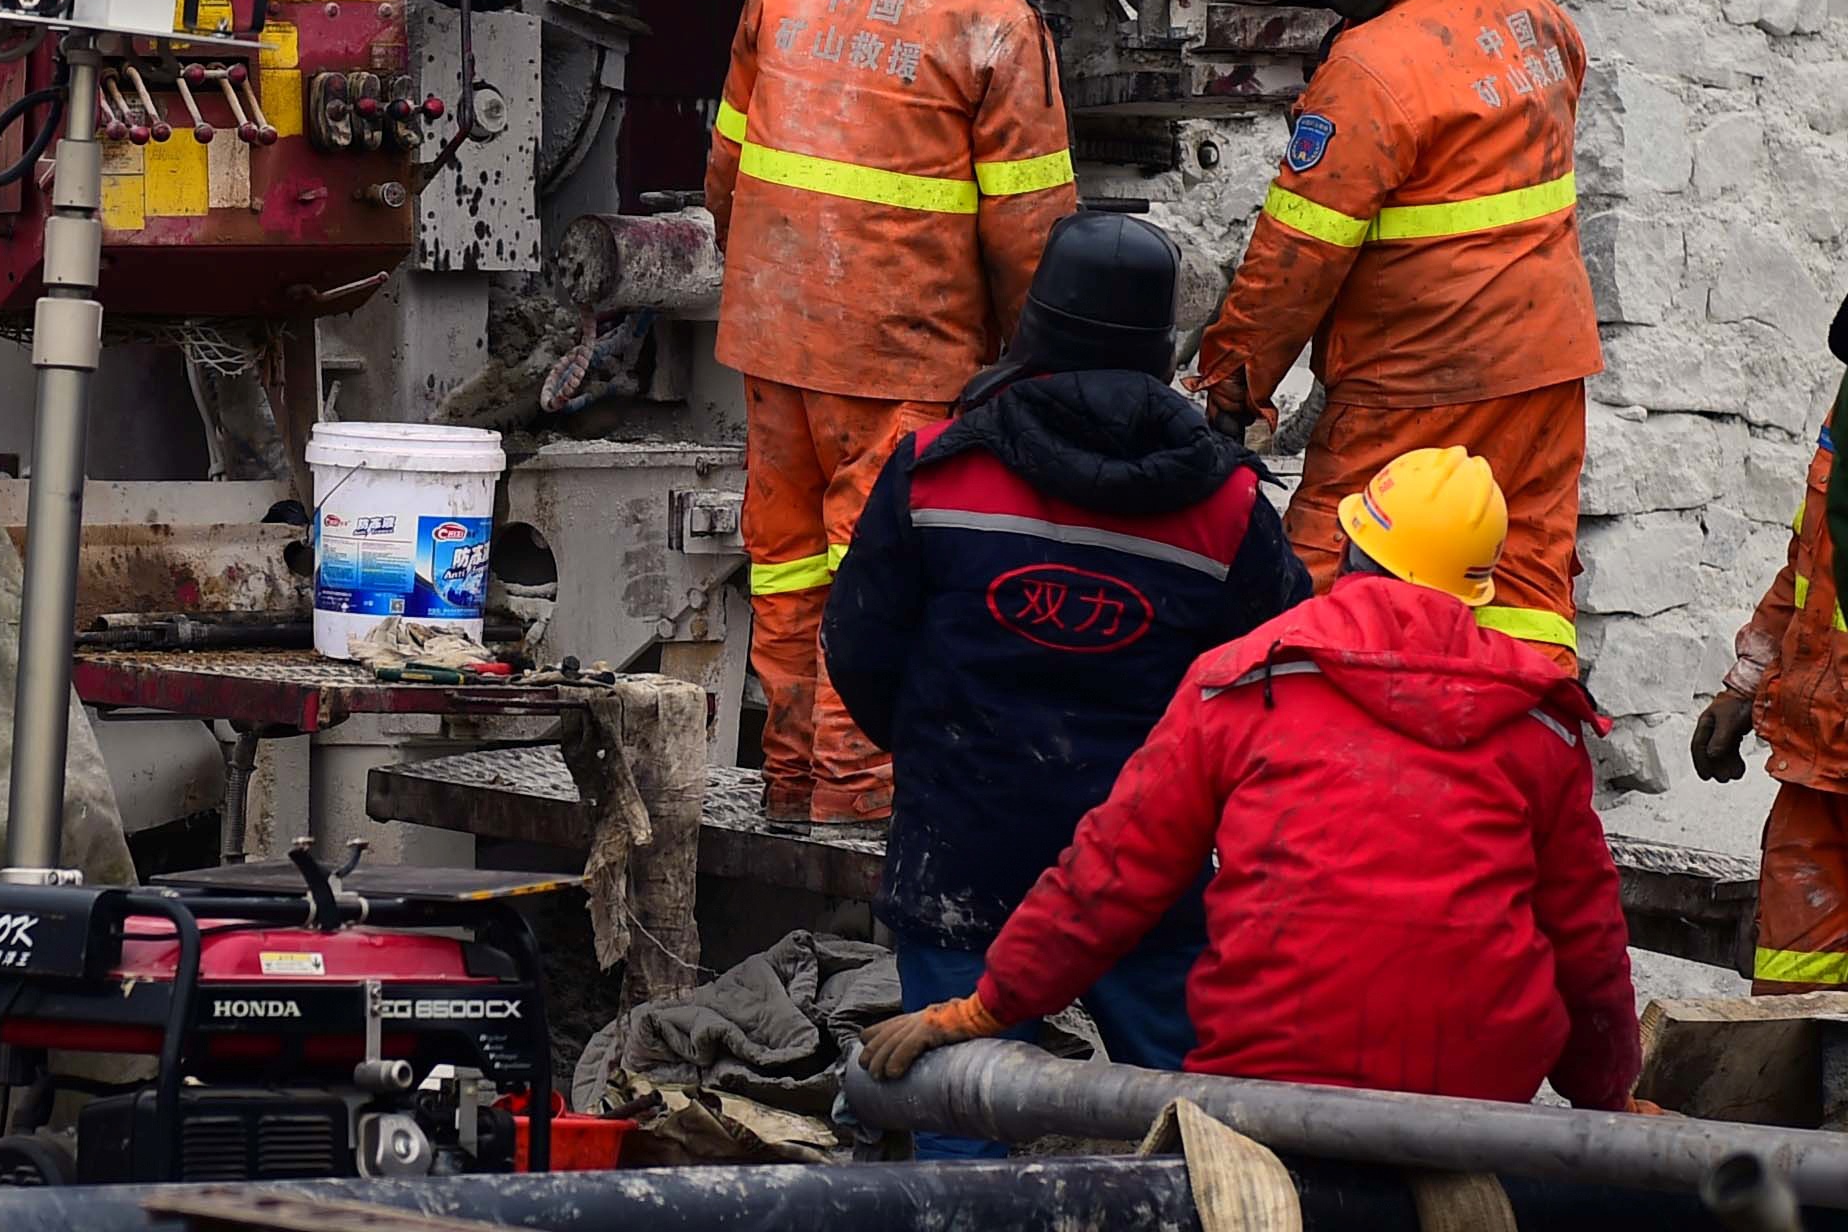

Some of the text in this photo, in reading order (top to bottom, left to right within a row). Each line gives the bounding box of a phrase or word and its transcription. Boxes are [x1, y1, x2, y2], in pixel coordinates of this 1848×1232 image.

[775, 16, 921, 83] 矿山救援
[1475, 9, 1537, 61] 中国
[1471, 44, 1567, 108] 矿山救援
[1015, 578, 1126, 636] 双力
[213, 1000, 302, 1017] HONDA
